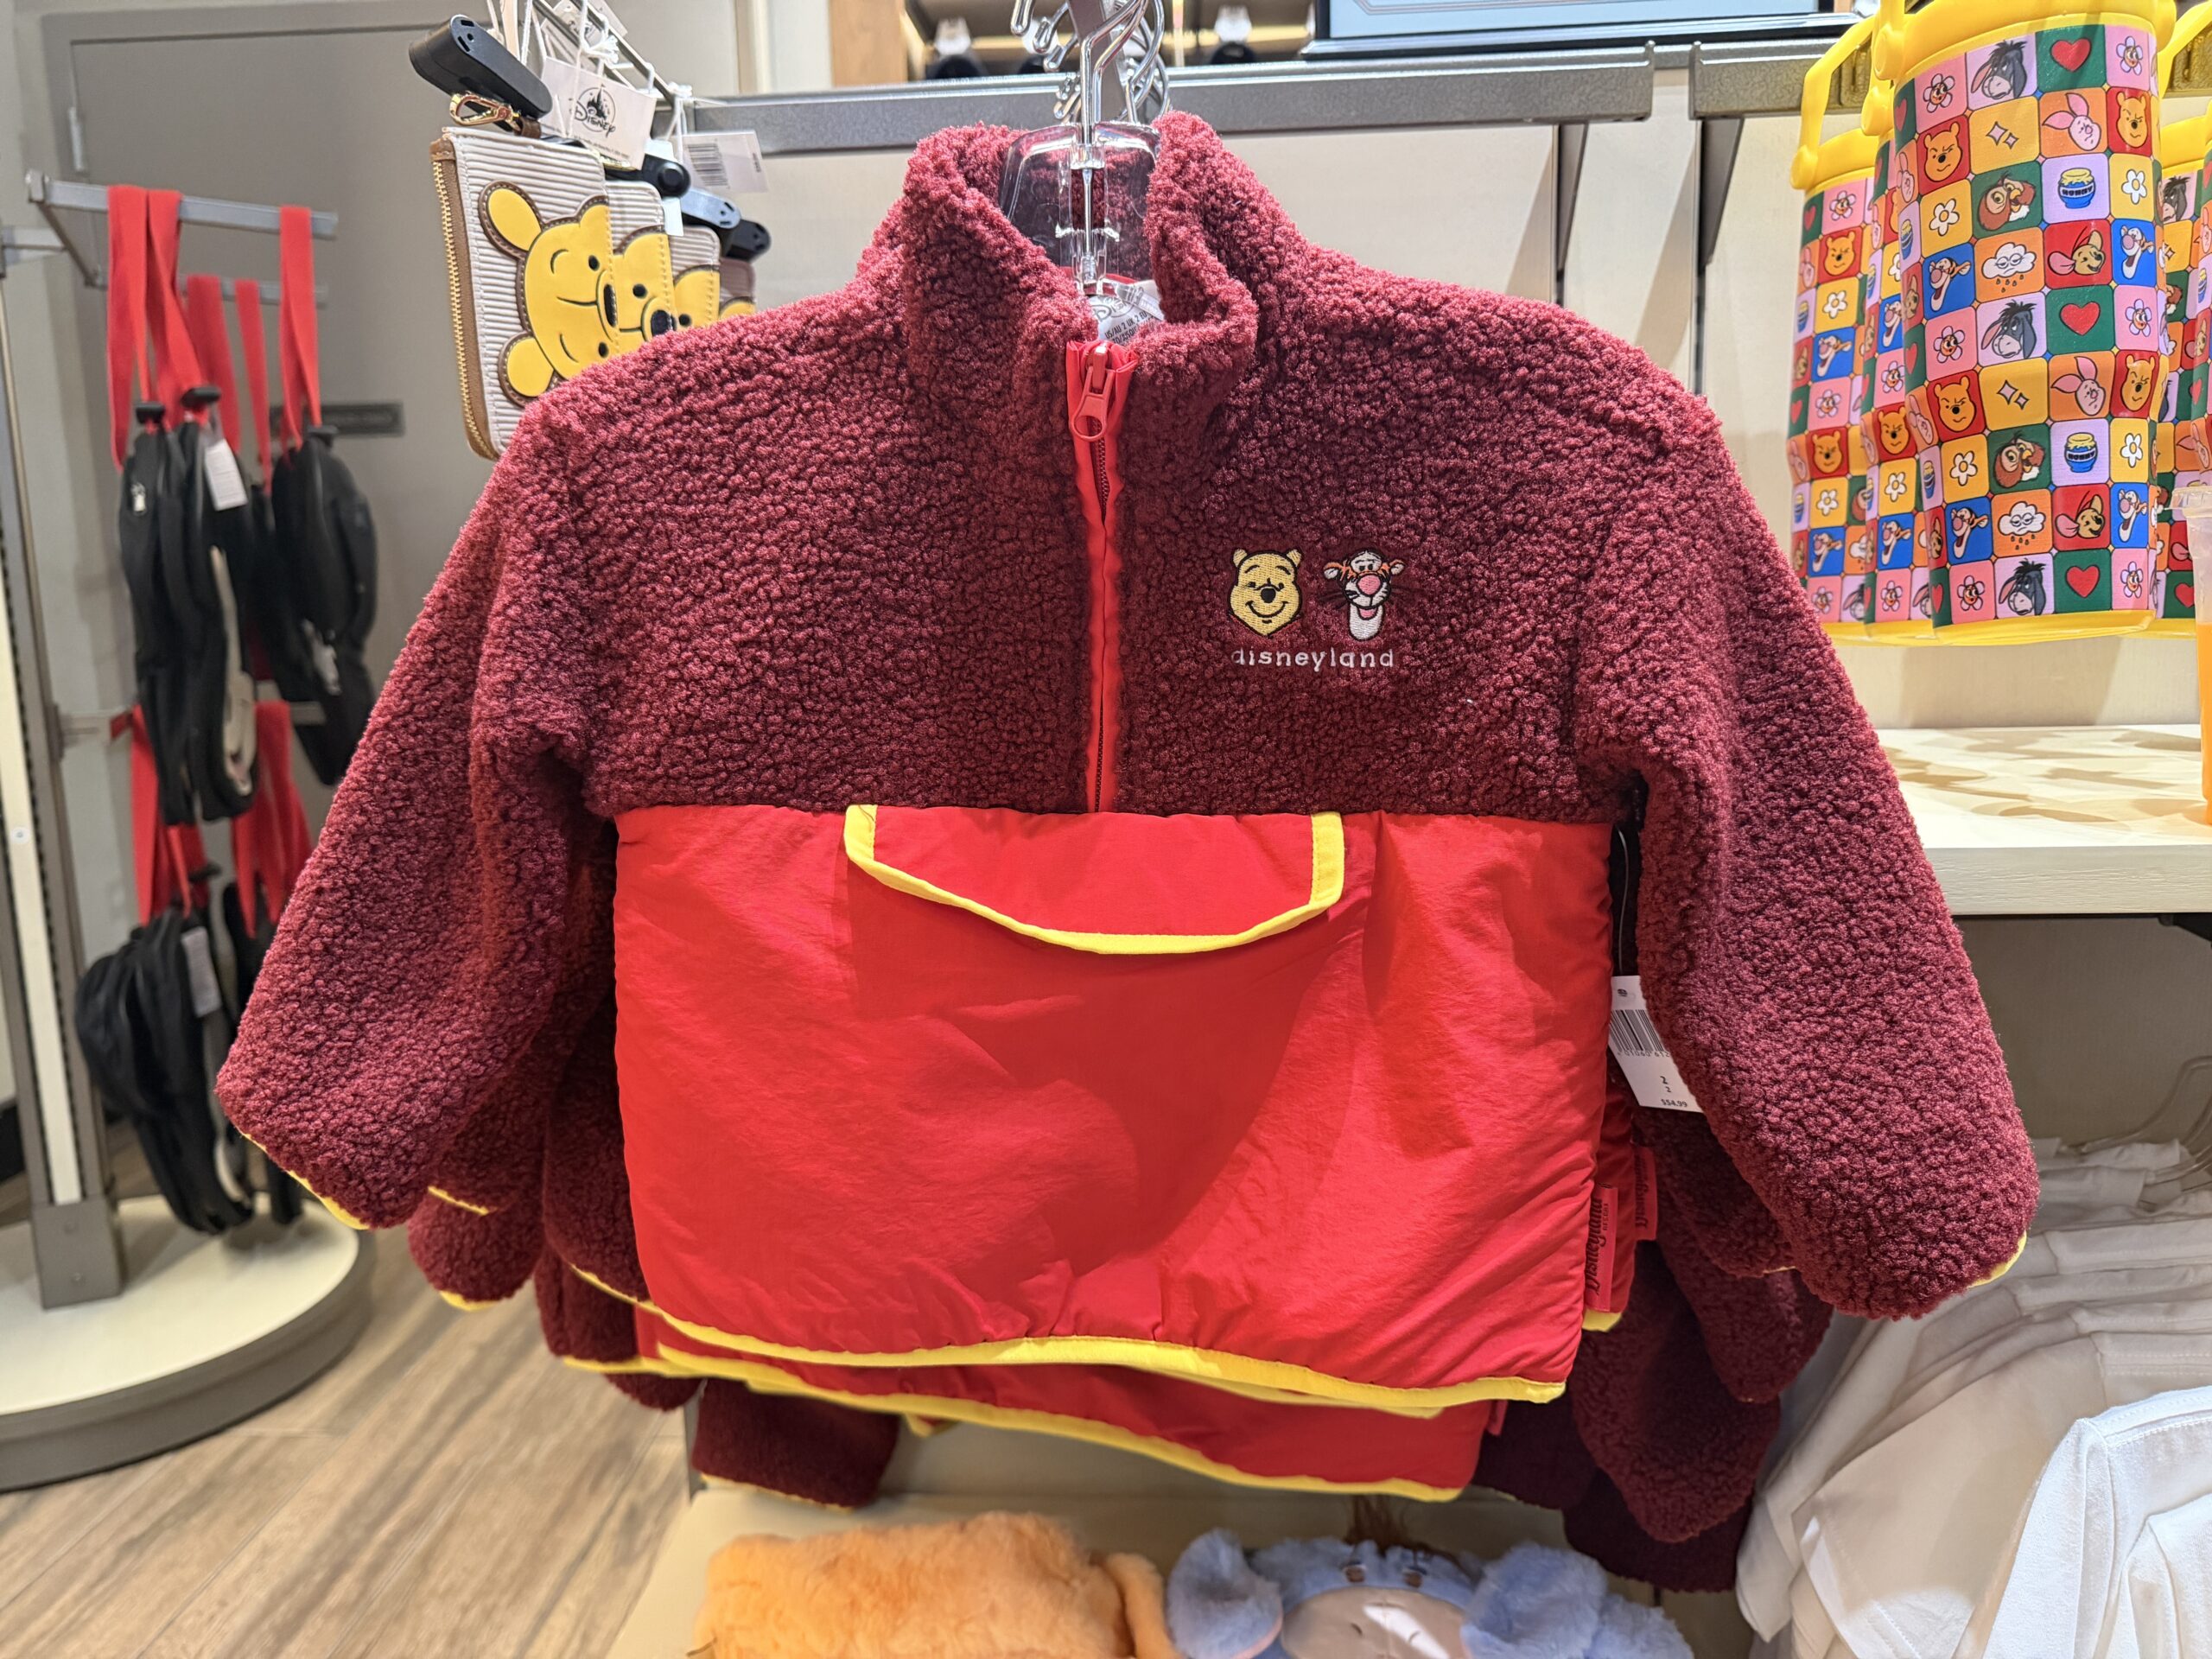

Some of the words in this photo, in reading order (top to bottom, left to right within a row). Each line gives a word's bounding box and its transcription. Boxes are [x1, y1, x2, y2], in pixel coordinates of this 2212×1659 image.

[1231, 647, 1394, 672] disneyland
[1660, 1076, 1669, 1084] 2
[1661, 1098, 1688, 1107] $54.99
